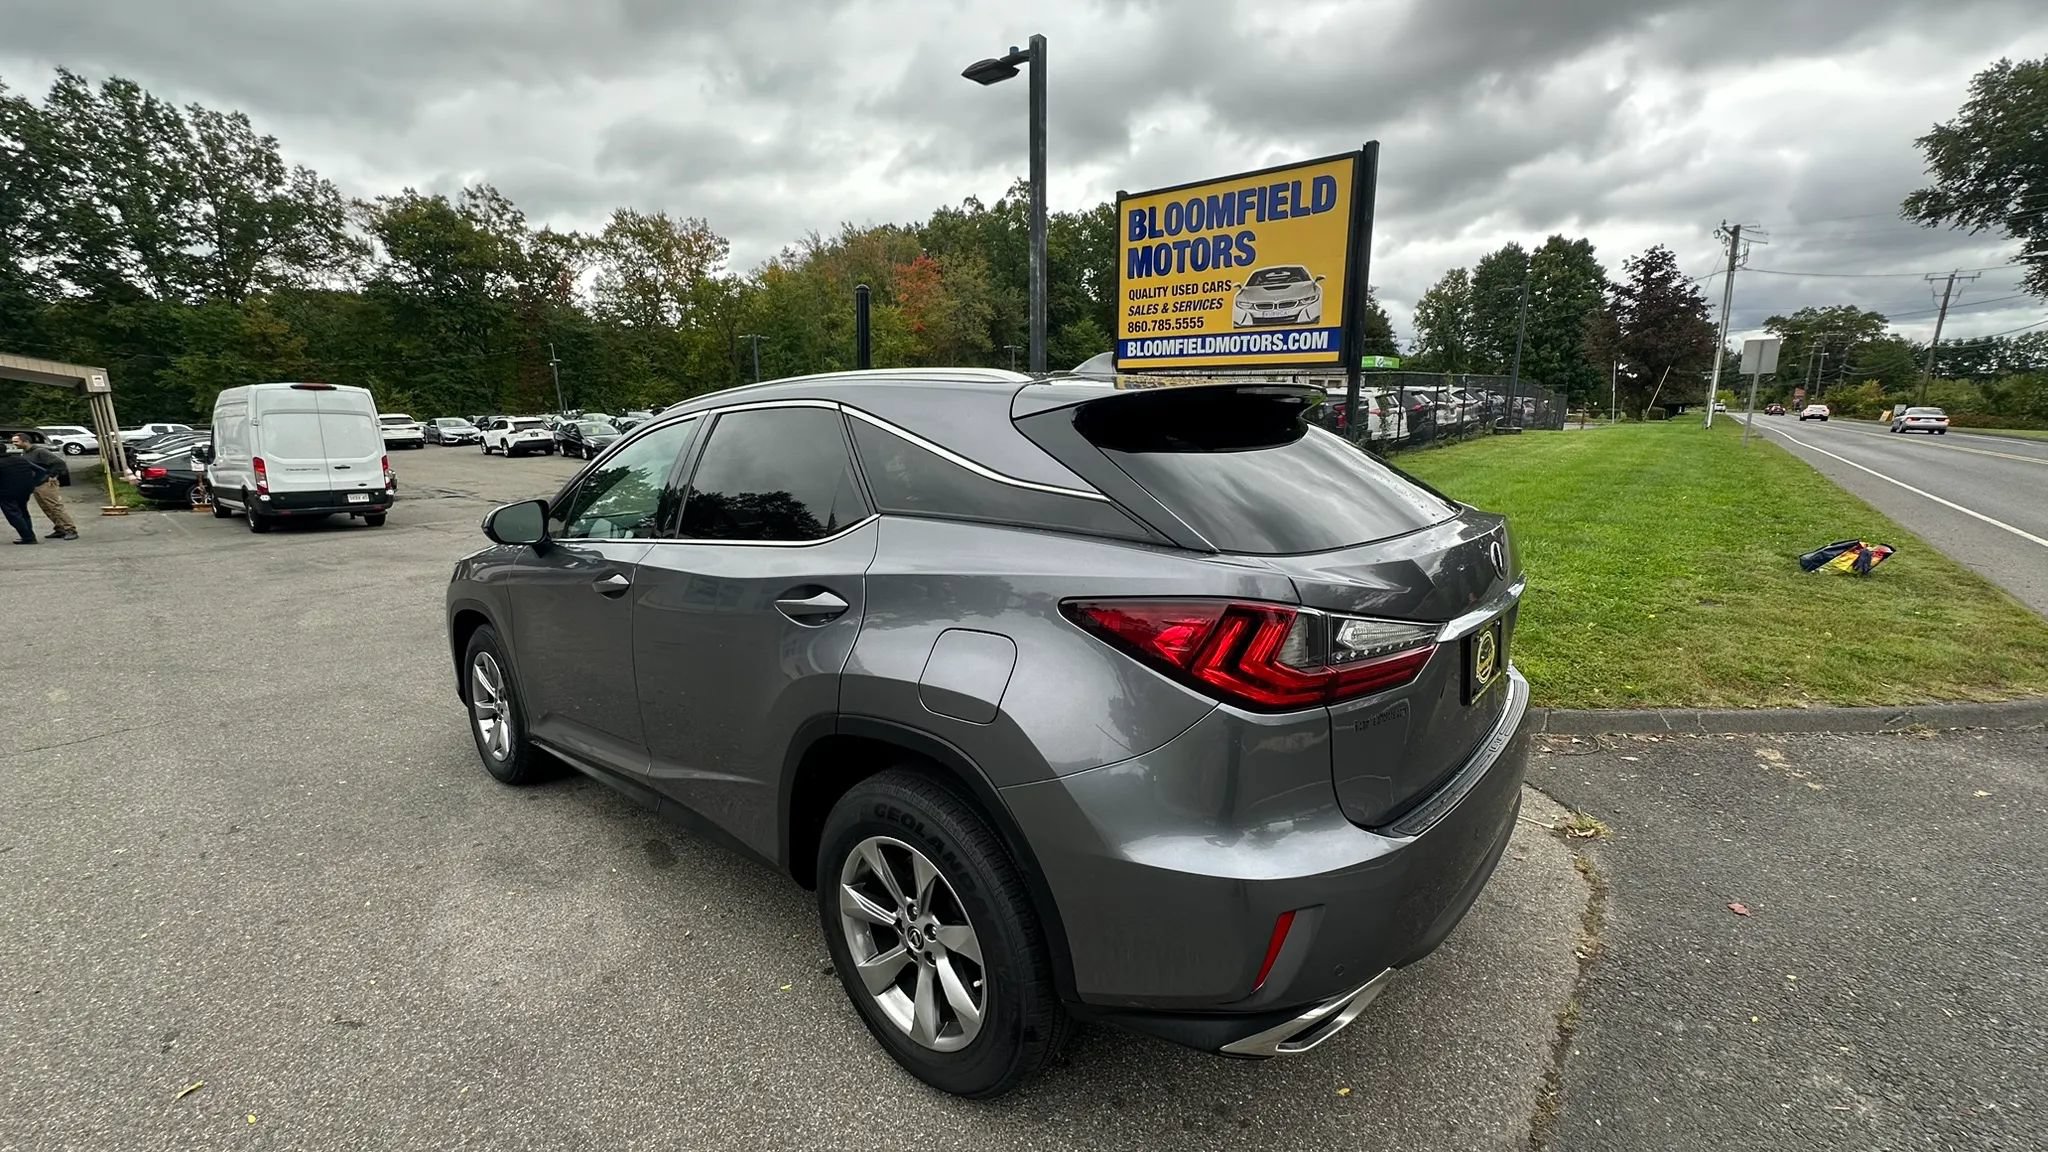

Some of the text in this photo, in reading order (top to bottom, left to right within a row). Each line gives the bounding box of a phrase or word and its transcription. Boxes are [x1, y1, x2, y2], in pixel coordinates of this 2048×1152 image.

[1128, 175, 1337, 242] BLOOMFIELD
[1127, 230, 1256, 279] MOTORS
[1128, 280, 1232, 301] QUALITY USED CARS
[1128, 297, 1224, 316] SALES & SERVICES
[1128, 316, 1205, 334] 860.785.5555
[1127, 331, 1329, 357] BLOOMFIELDMOTORS.COM
